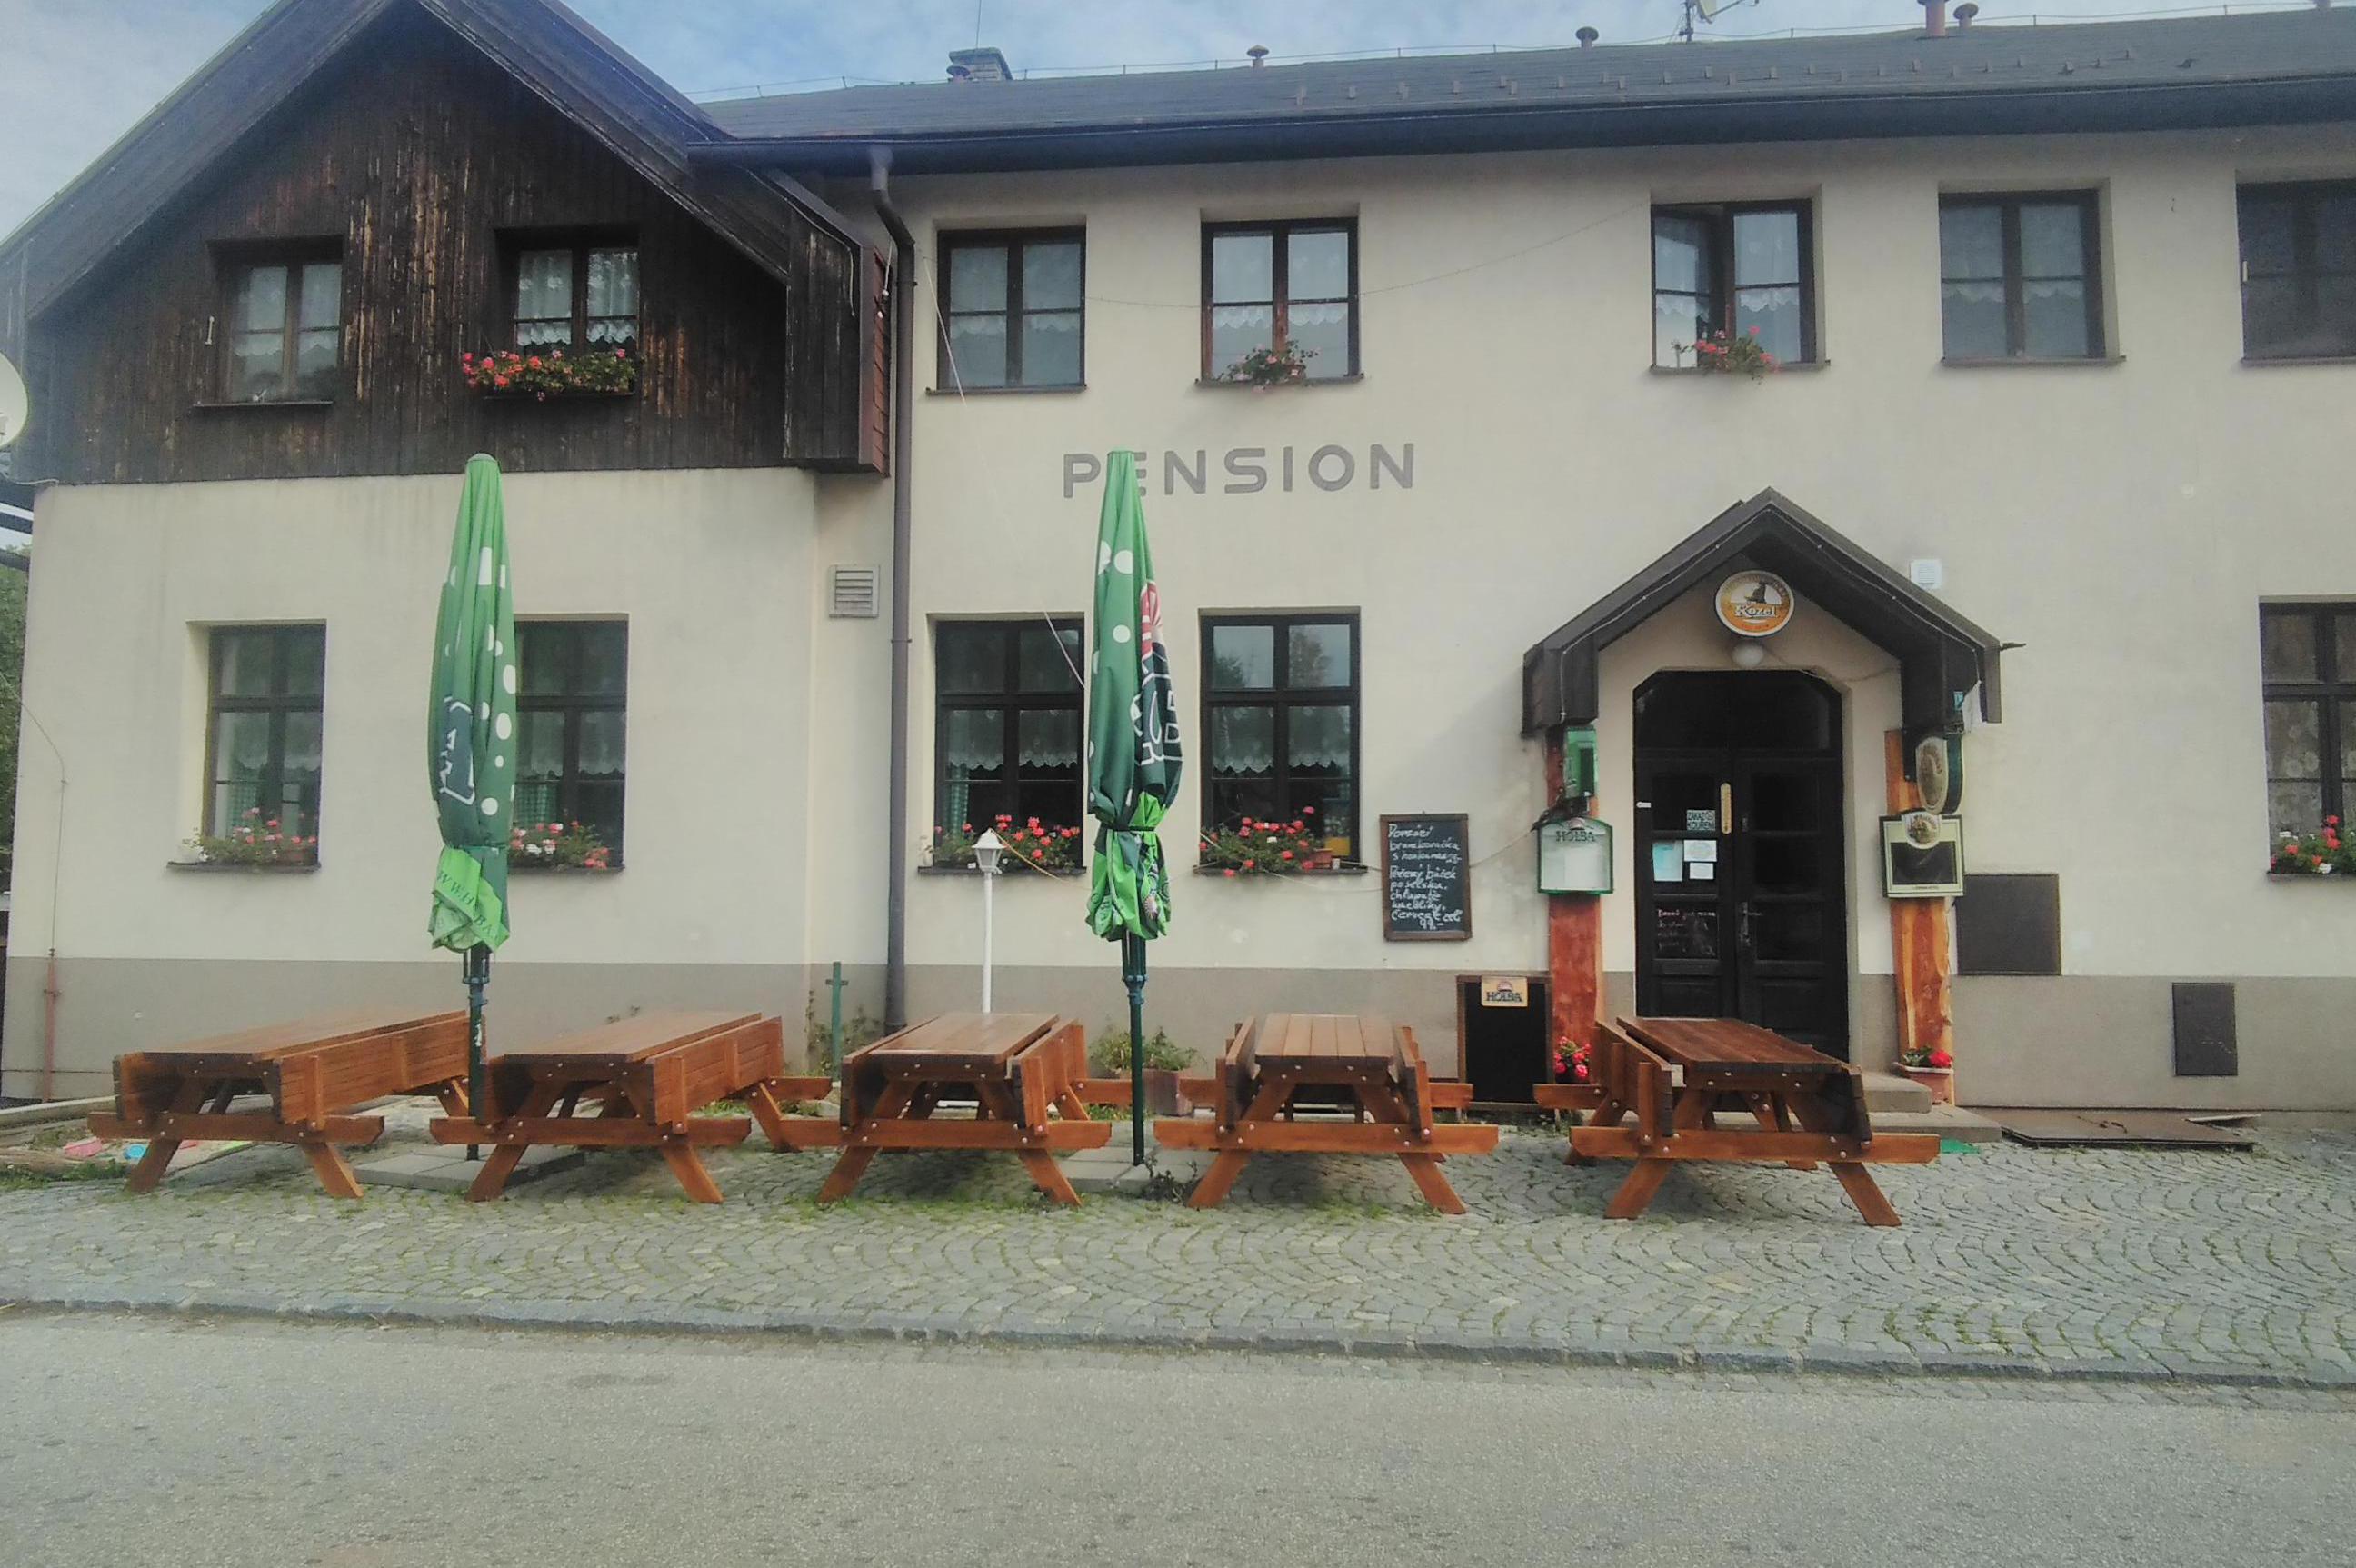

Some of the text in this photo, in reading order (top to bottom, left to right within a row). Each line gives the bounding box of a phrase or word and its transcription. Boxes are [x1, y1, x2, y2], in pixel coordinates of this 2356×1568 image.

[1734, 603, 1776, 619] Kozel
[1555, 830, 1596, 843] HOLBA
[1486, 991, 1522, 1002] HOLBA
